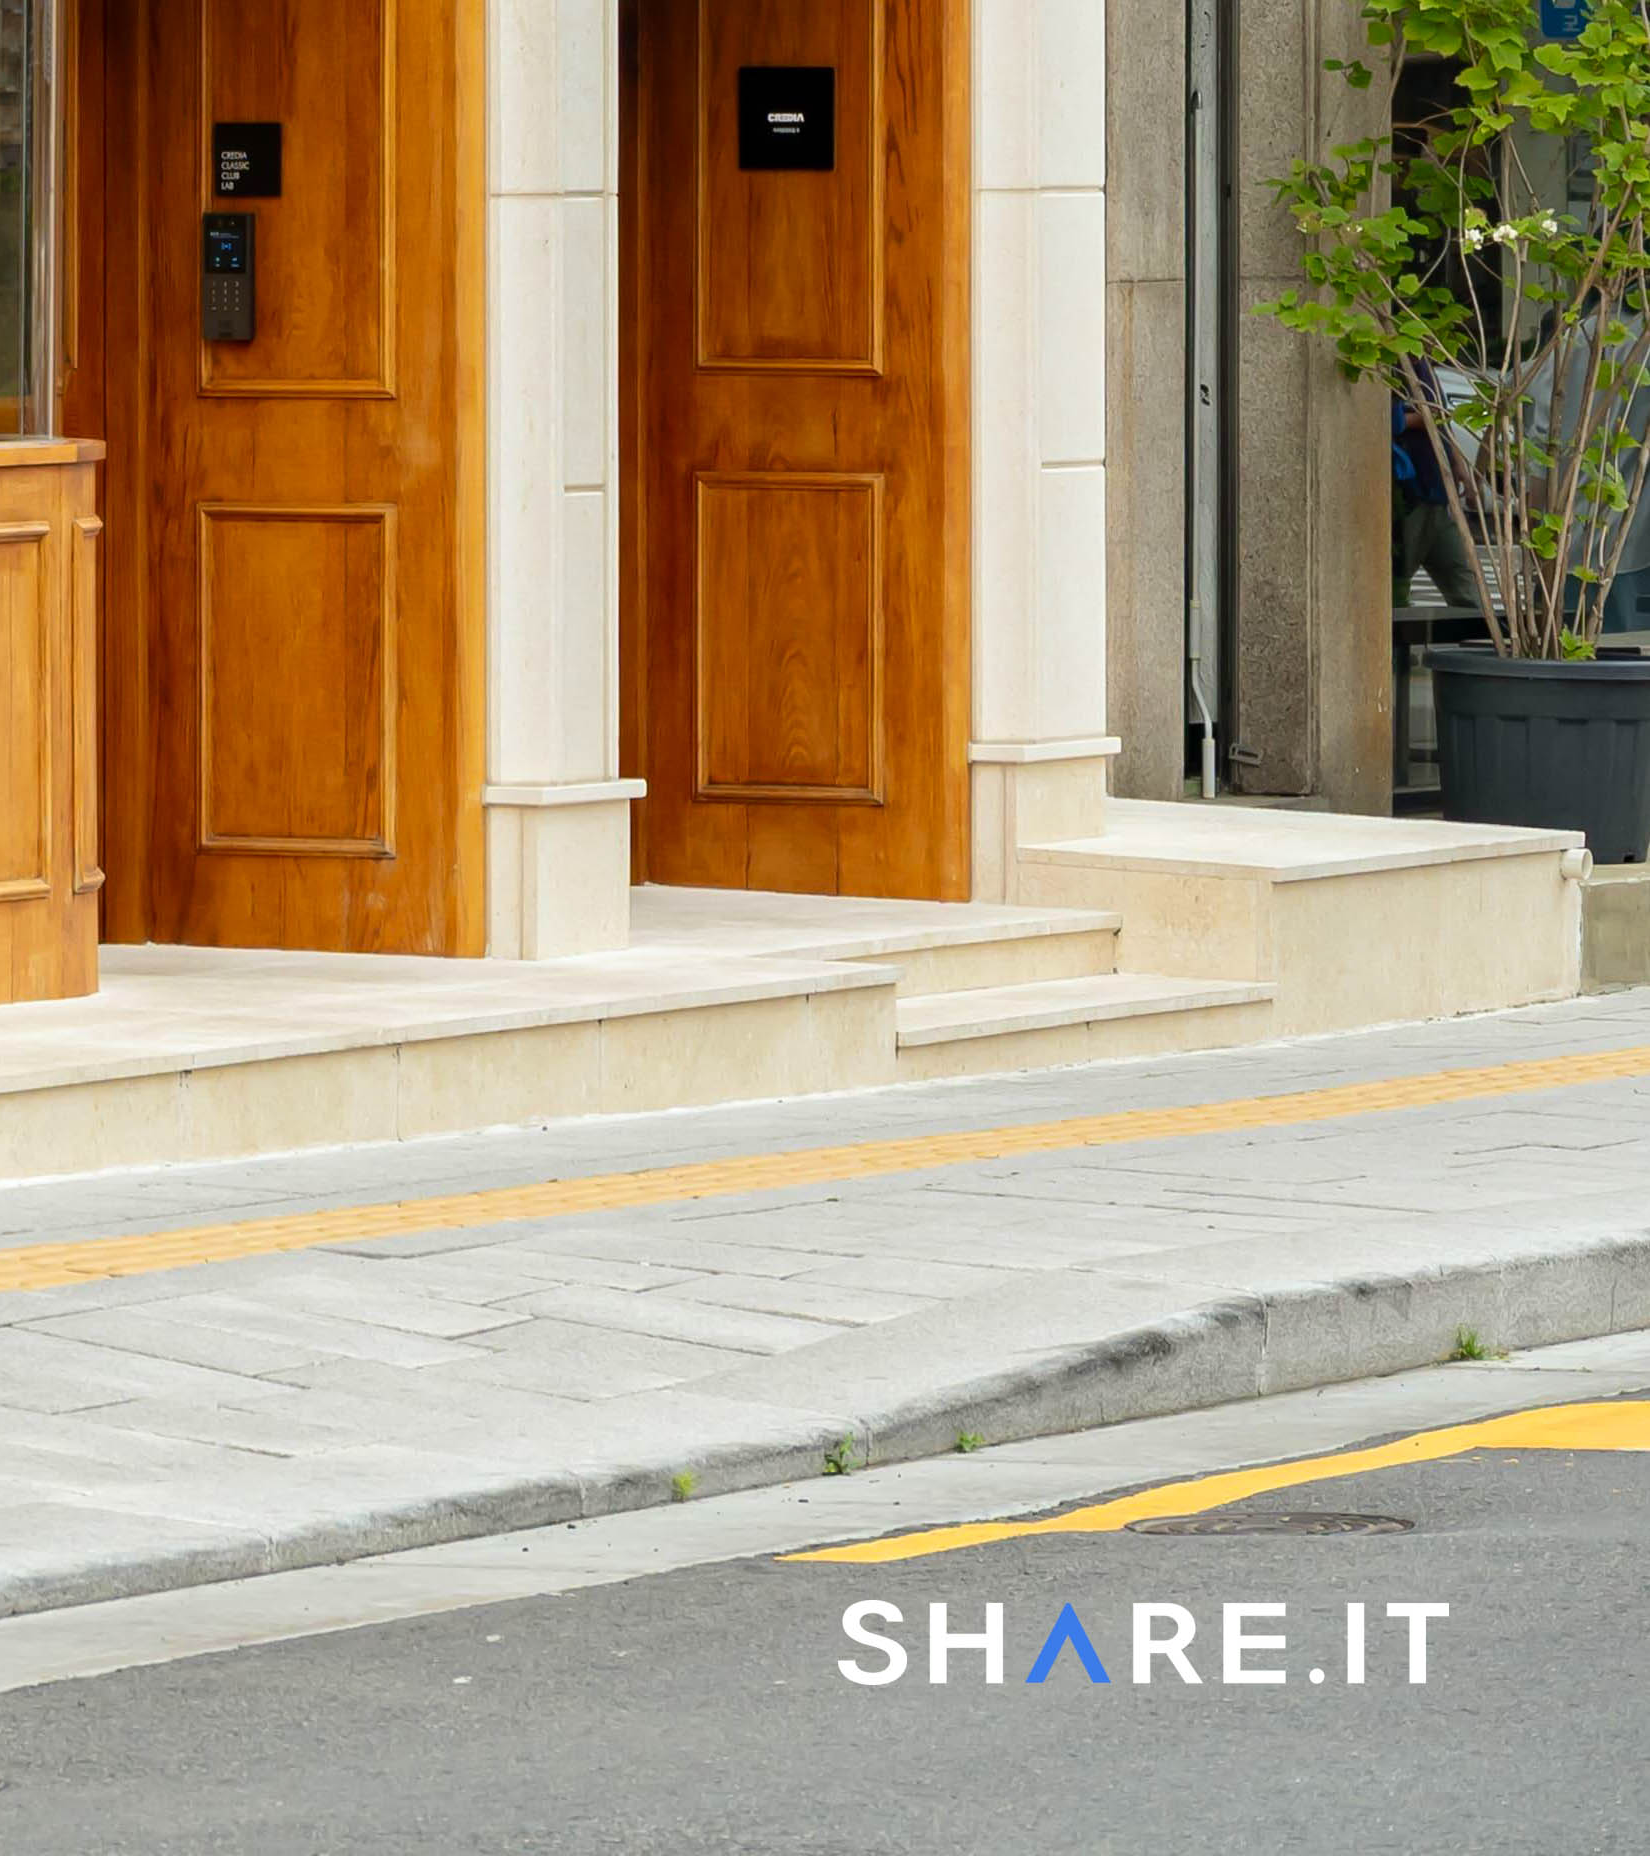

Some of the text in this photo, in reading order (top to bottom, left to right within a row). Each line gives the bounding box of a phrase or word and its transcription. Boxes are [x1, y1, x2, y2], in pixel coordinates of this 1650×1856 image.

[220, 151, 248, 161] CREDIA
[220, 161, 250, 171] CLASSIC
[220, 171, 241, 181] CLUB
[220, 181, 235, 191] LAB
